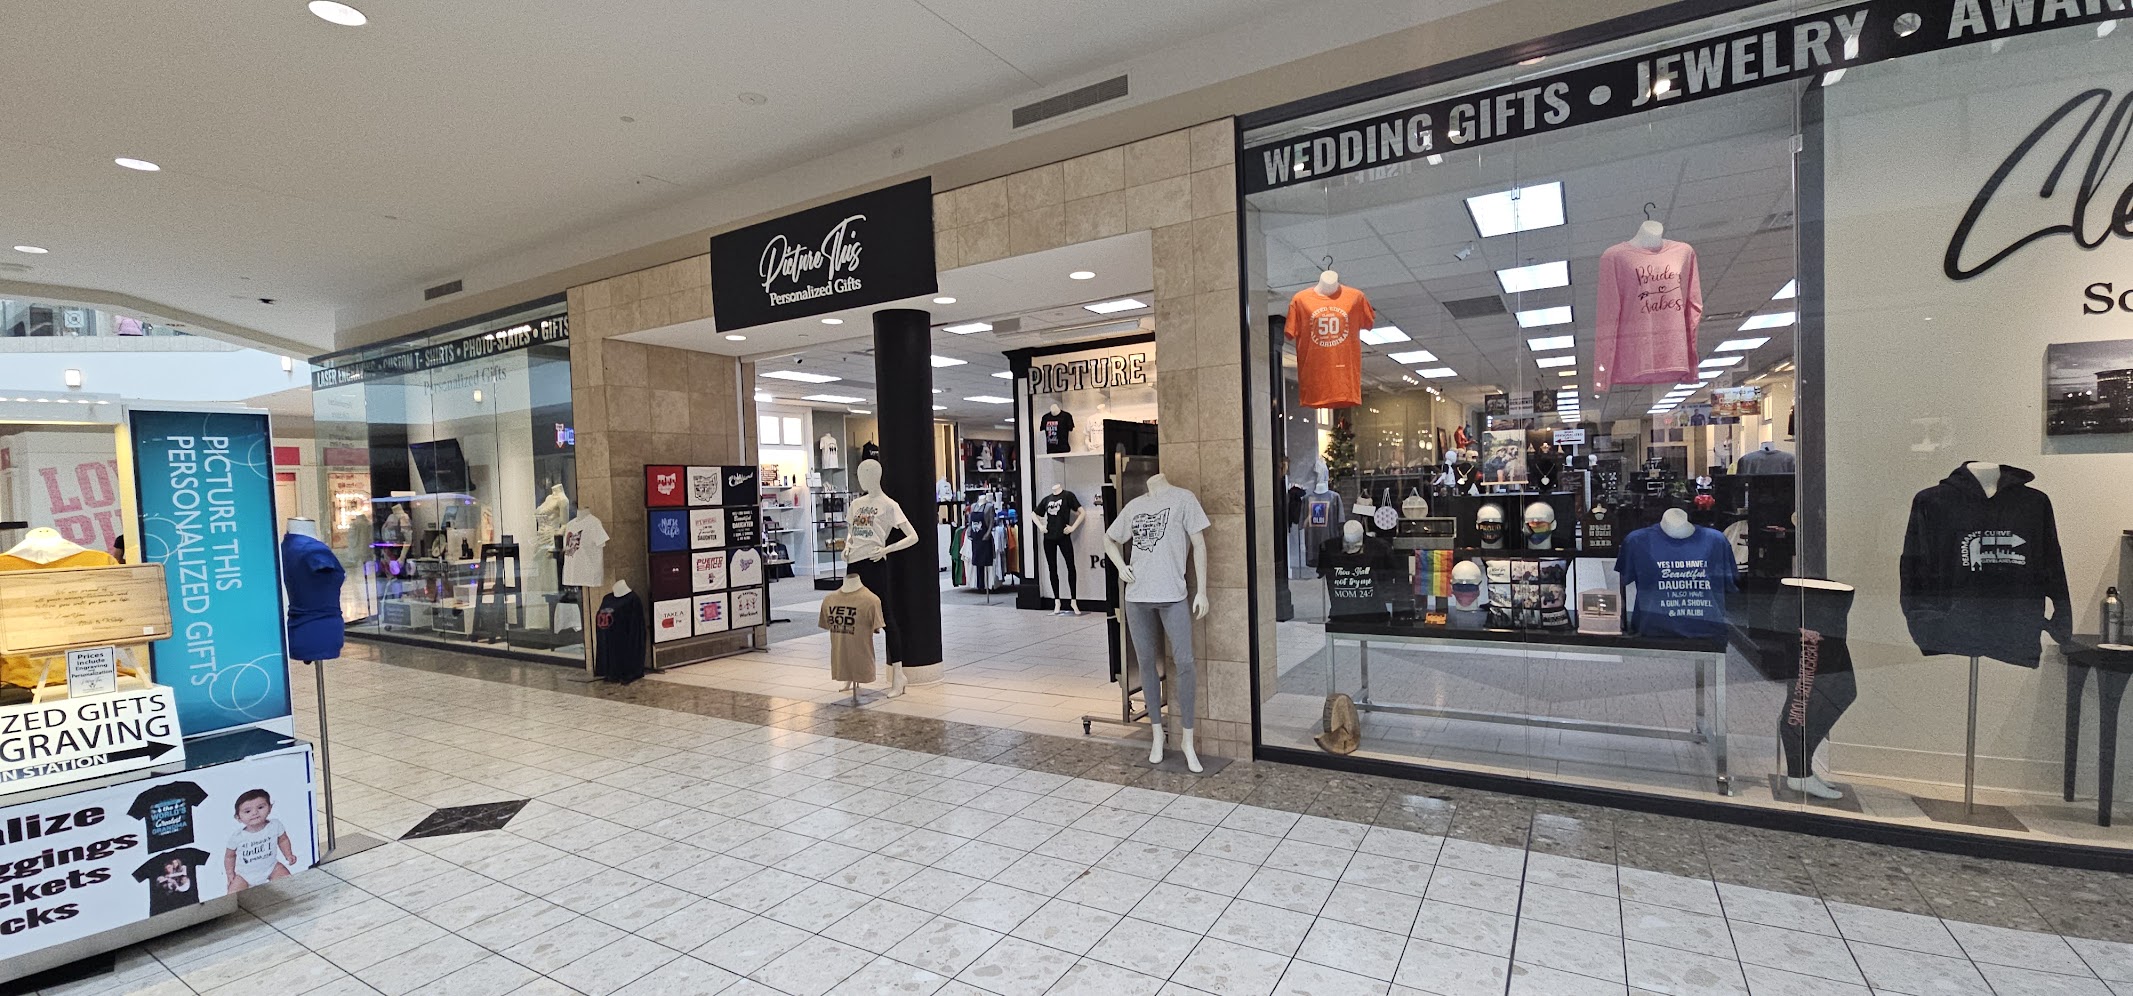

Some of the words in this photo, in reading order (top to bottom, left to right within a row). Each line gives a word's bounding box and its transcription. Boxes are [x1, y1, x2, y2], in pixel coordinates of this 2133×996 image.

[1263, 113, 1433, 185] WEDDING
[1449, 81, 1571, 145] GIFTS
[1632, 9, 1869, 107] JEWELRY
[1947, 0, 2133, 40] AW
[759, 234, 824, 293] Picture
[821, 214, 867, 281] This
[769, 280, 834, 306] Personalized
[834, 277, 862, 295] Gifts
[1318, 317, 1340, 335] 50
[317, 369, 338, 388] LASER
[424, 343, 455, 367] SHIRTS
[540, 316, 569, 341] GIFTS
[481, 366, 508, 384] Gifts
[1027, 352, 1147, 395] PICTURE
[38, 458, 117, 515] LO
[201, 435, 237, 534] PICTURE
[54, 507, 123, 559] PI
[166, 435, 210, 614] PERSONALIZED
[211, 543, 243, 591] THIS
[696, 556, 723, 567] PUERTO
[1657, 561, 1670, 569] YES
[1675, 560, 1685, 569] DO
[1685, 560, 1704, 568] HAVE
[1333, 566, 1351, 577] Thou
[1661, 568, 1707, 580] Beautiful
[1334, 577, 1348, 586] not
[1658, 580, 1711, 590] DAUGHTER
[1334, 590, 1357, 598] MOM
[1687, 599, 1713, 607] SHOVEL
[1668, 609, 1677, 617] &
[1676, 608, 1686, 617] AN
[1686, 608, 1704, 616] ALIBI
[76, 658, 106, 667] Include
[77, 651, 104, 660] Prices
[186, 621, 218, 687] GIFTS
[71, 669, 113, 679] Personalization
[75, 663, 108, 672] Engraving
[1, 708, 67, 735] ZED
[77, 694, 167, 724] GIFTS
[0, 715, 170, 763] GRAVING
[2, 769, 18, 782] N
[22, 753, 108, 778] STATION
[150, 807, 187, 821] WORLD'S
[0, 806, 106, 847] lize
[151, 821, 188, 836] GRANDMA
[1, 903, 80, 936] cks
